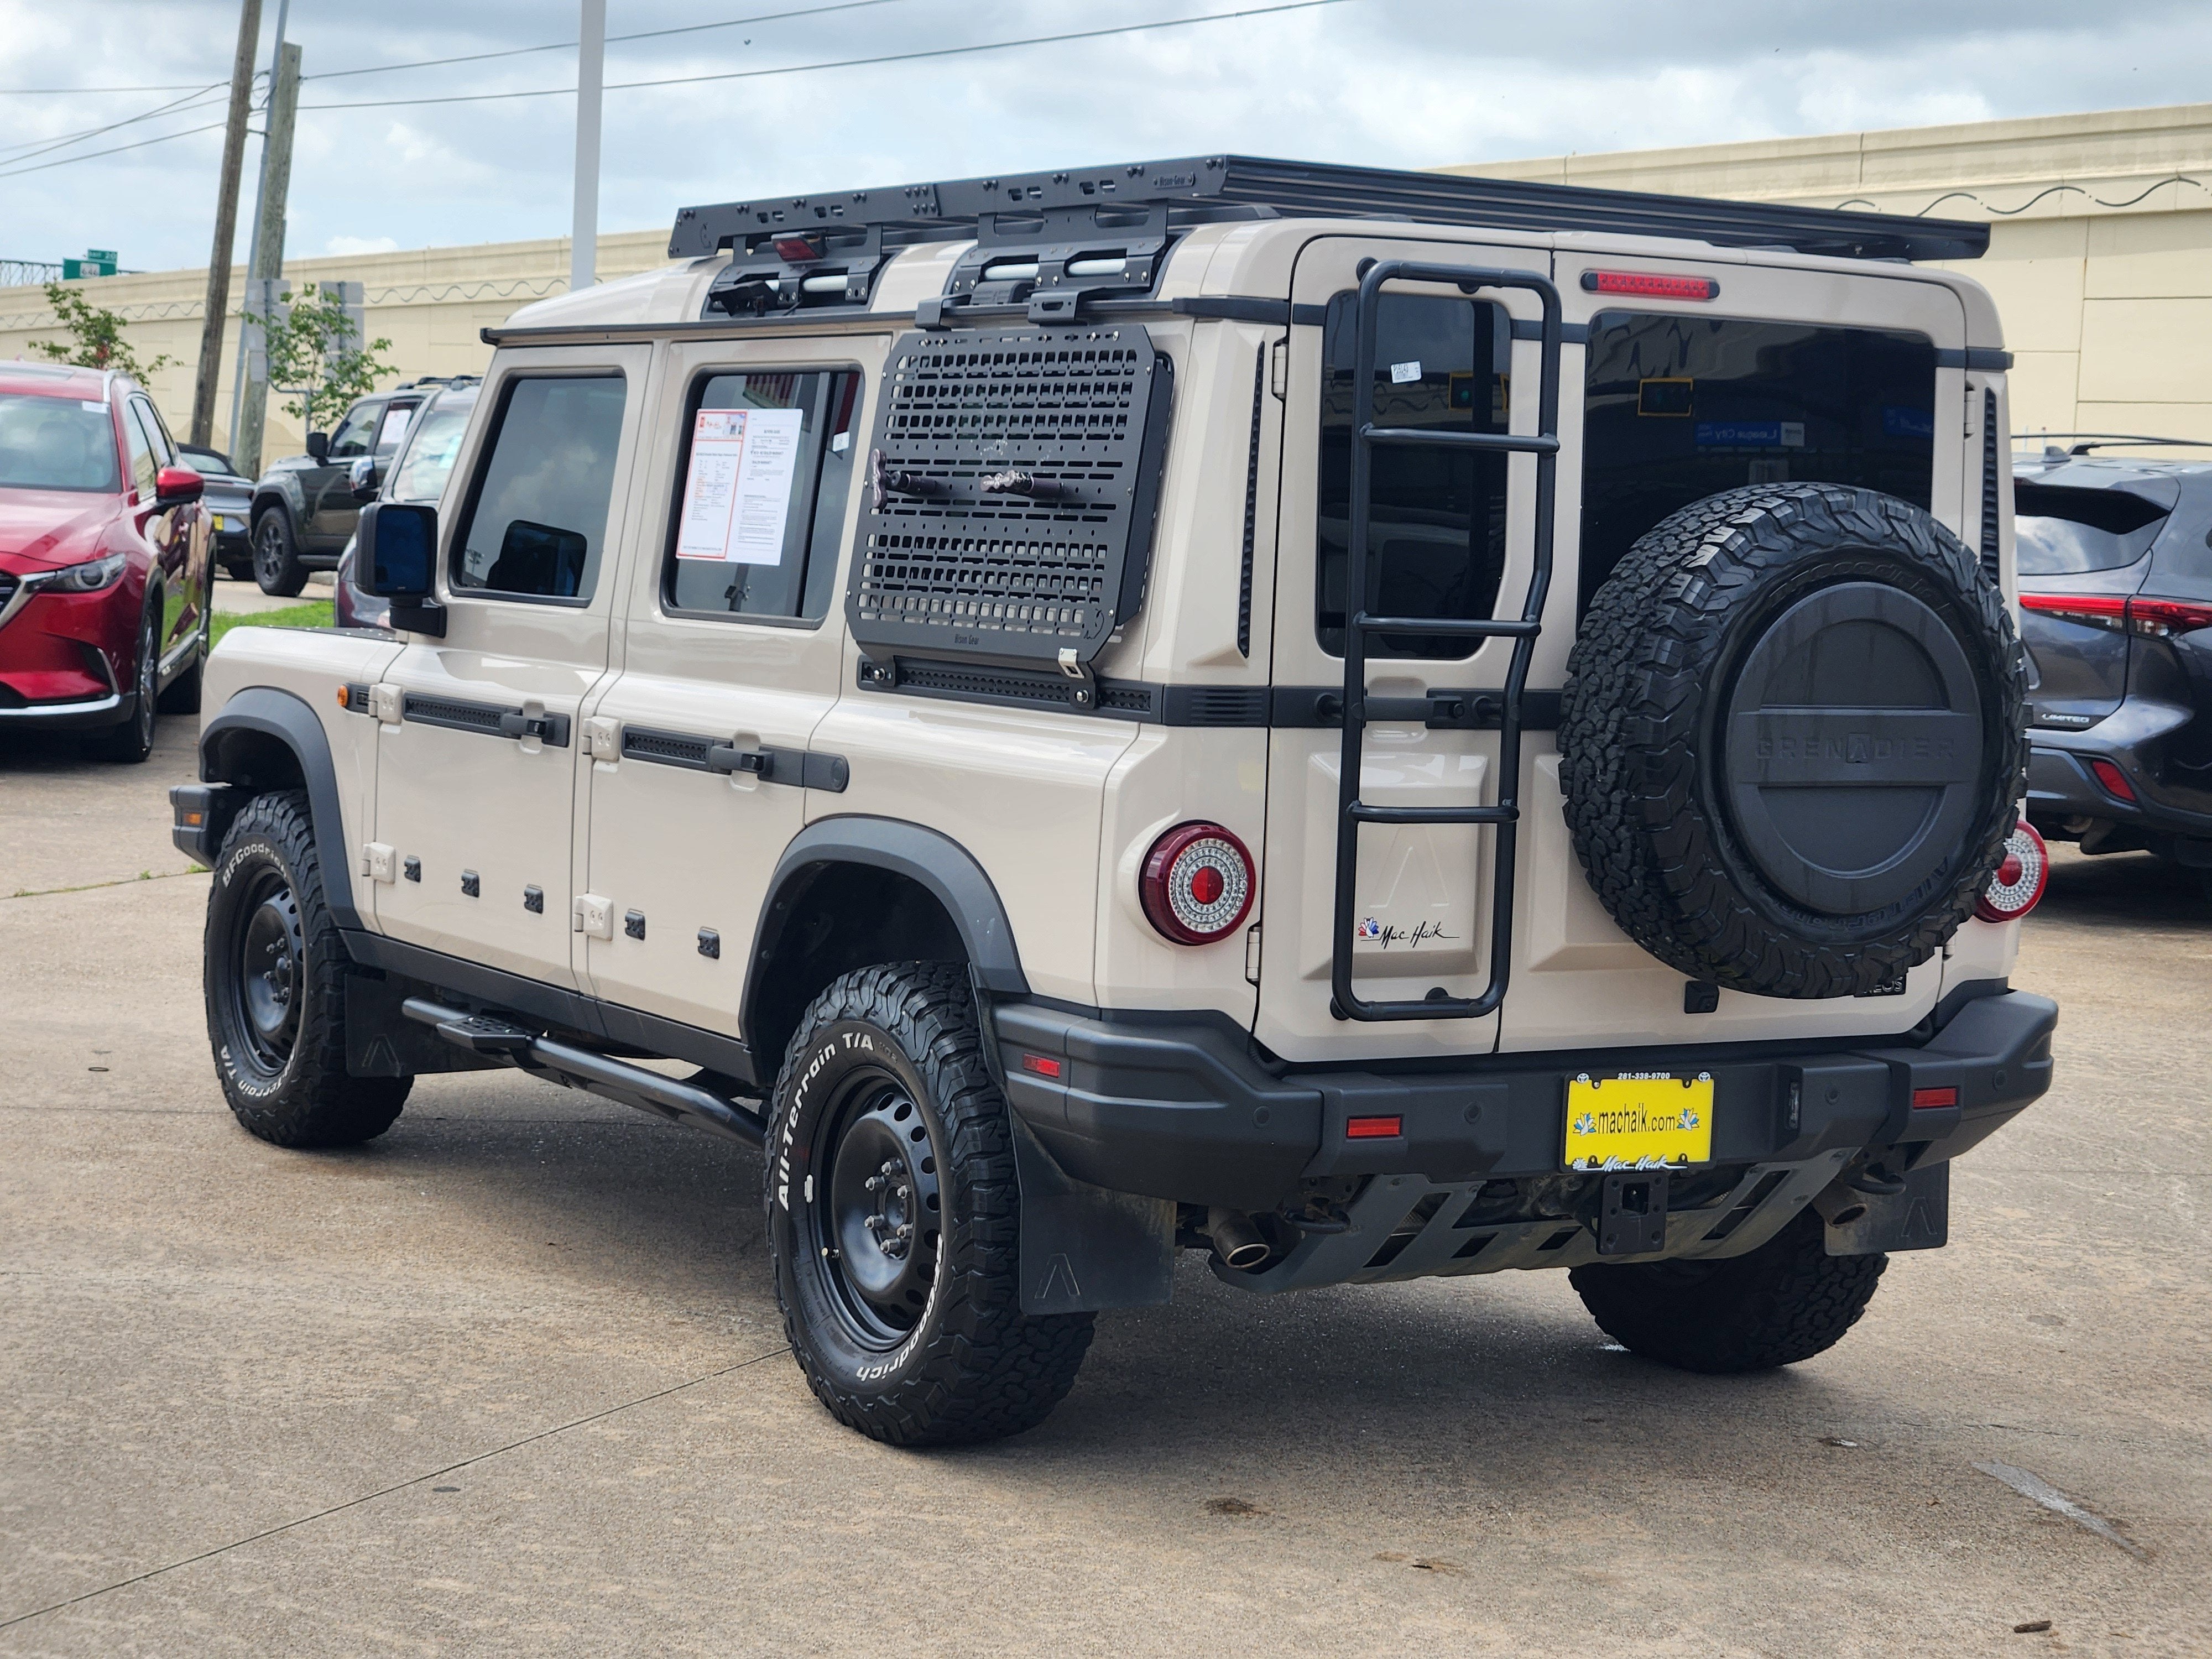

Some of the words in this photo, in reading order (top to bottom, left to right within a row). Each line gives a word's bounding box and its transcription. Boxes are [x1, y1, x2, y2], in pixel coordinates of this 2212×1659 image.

[968, 634, 979, 645] Gear
[2042, 713, 2090, 723] LIMITED
[1755, 735, 1955, 761] GRENADIER
[223, 843, 286, 888] BFGoodrich
[1373, 925, 1409, 949] Mac
[1410, 921, 1453, 948] Haik
[221, 1045, 237, 1080] T/A
[778, 1042, 836, 1212] All-Terrain
[842, 1032, 874, 1051] T/A
[1598, 1103, 1675, 1134] machaik.com
[1599, 1155, 1634, 1172] Mac
[1635, 1155, 1676, 1171] Haik
[856, 1233, 943, 1381] BFGoodrich
